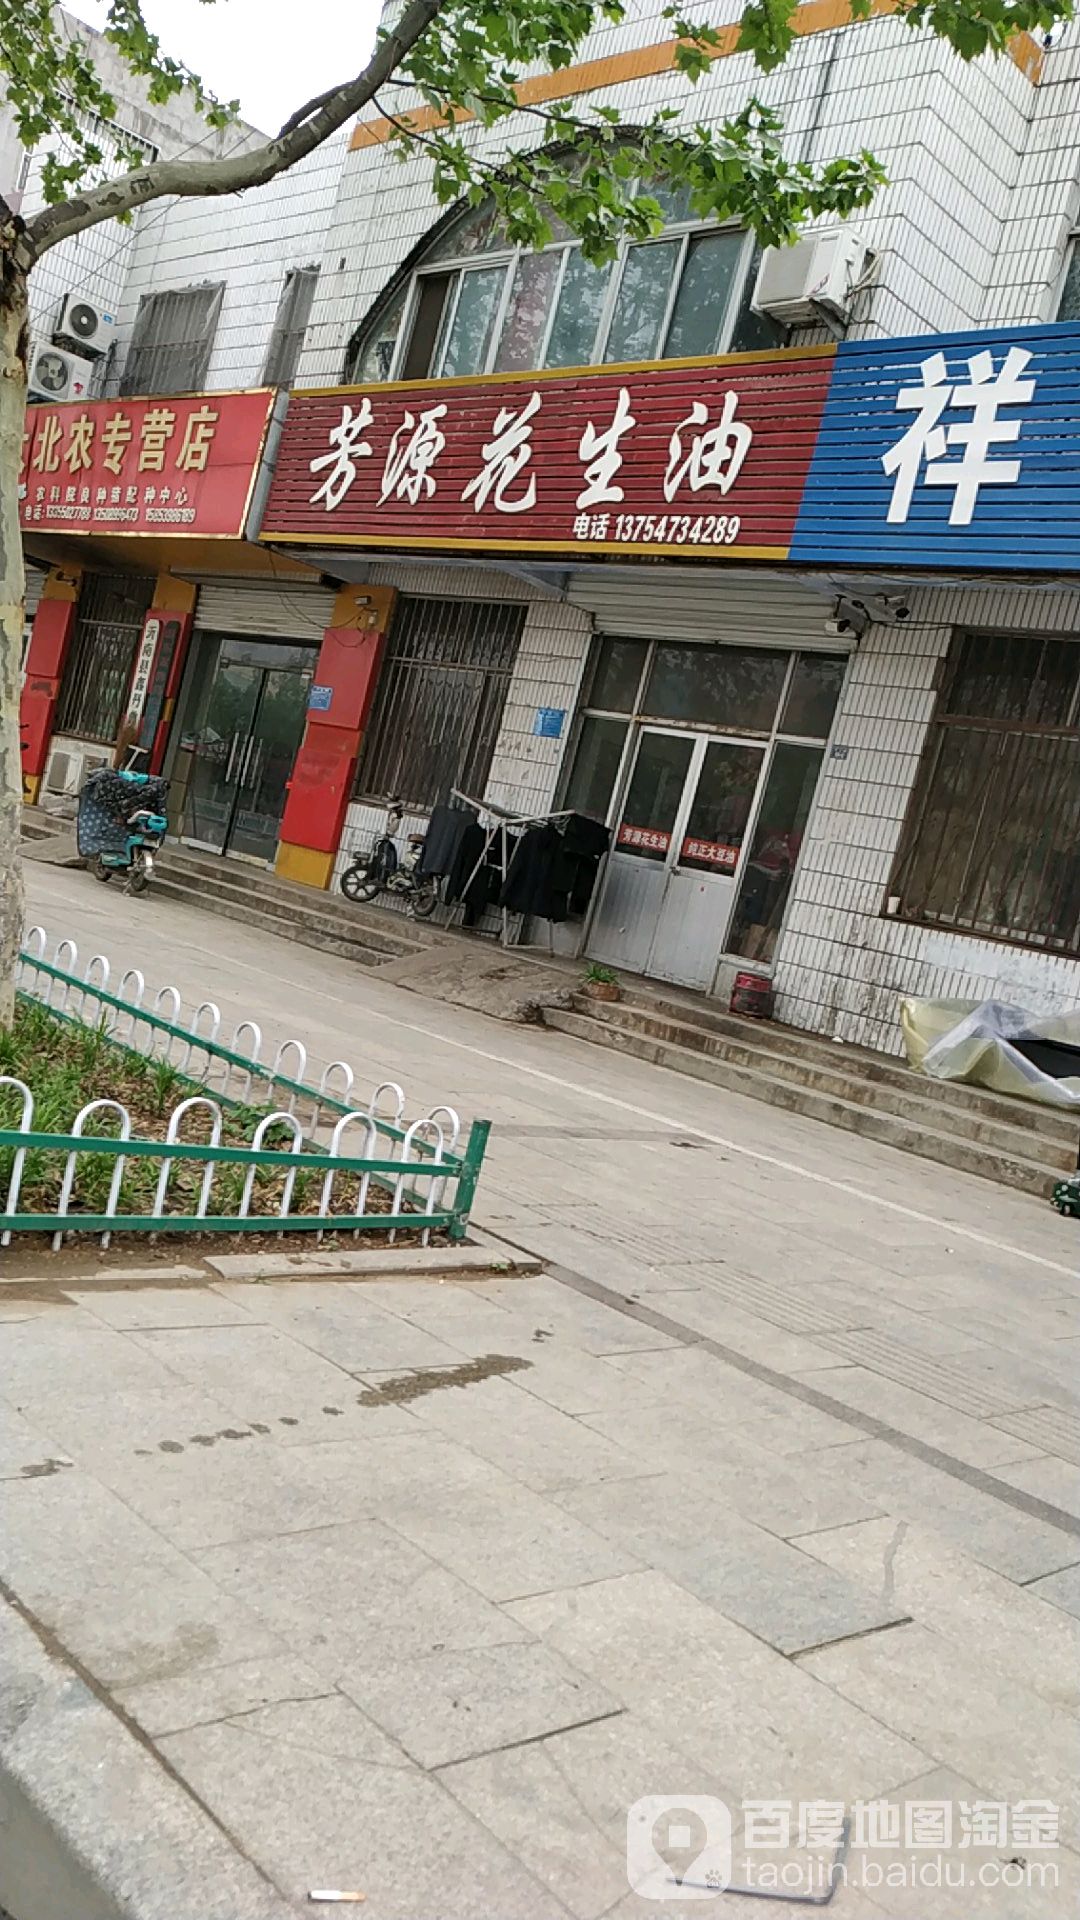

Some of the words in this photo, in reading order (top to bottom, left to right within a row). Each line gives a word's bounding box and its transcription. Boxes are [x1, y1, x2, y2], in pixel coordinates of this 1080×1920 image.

[309, 388, 753, 513] 芳源花生油
[881, 346, 1037, 526] 祥
[572, 512, 611, 540] 电话
[614, 513, 741, 543] 13754734289
[623, 828, 668, 850] 芳源花生油
